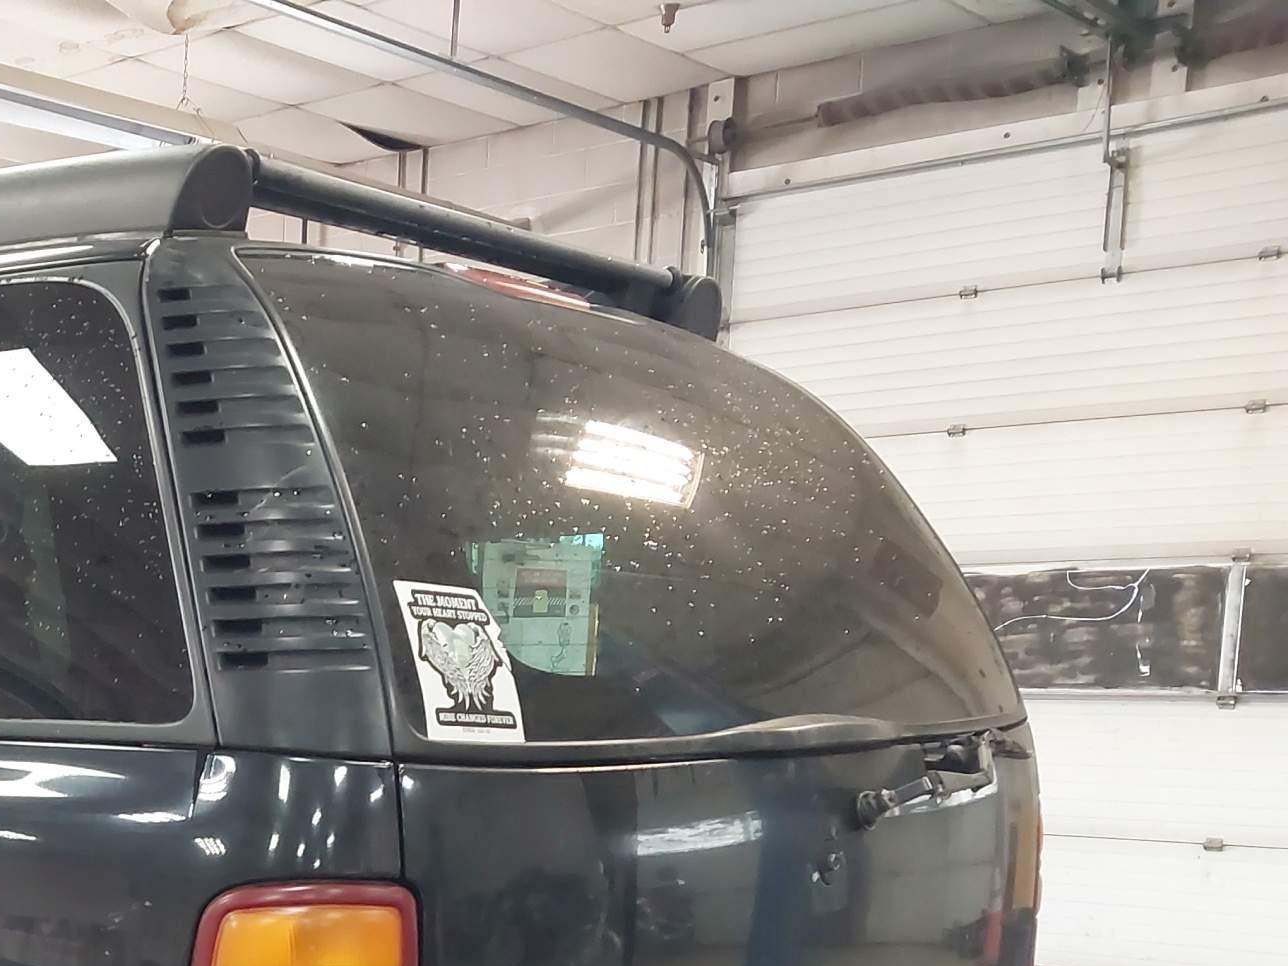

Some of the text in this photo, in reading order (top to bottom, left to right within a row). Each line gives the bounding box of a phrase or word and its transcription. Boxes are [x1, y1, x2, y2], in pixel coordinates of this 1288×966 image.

[414, 593, 477, 611] THE MOMENT
[411, 606, 488, 622] YOUR HEART STOPPED
